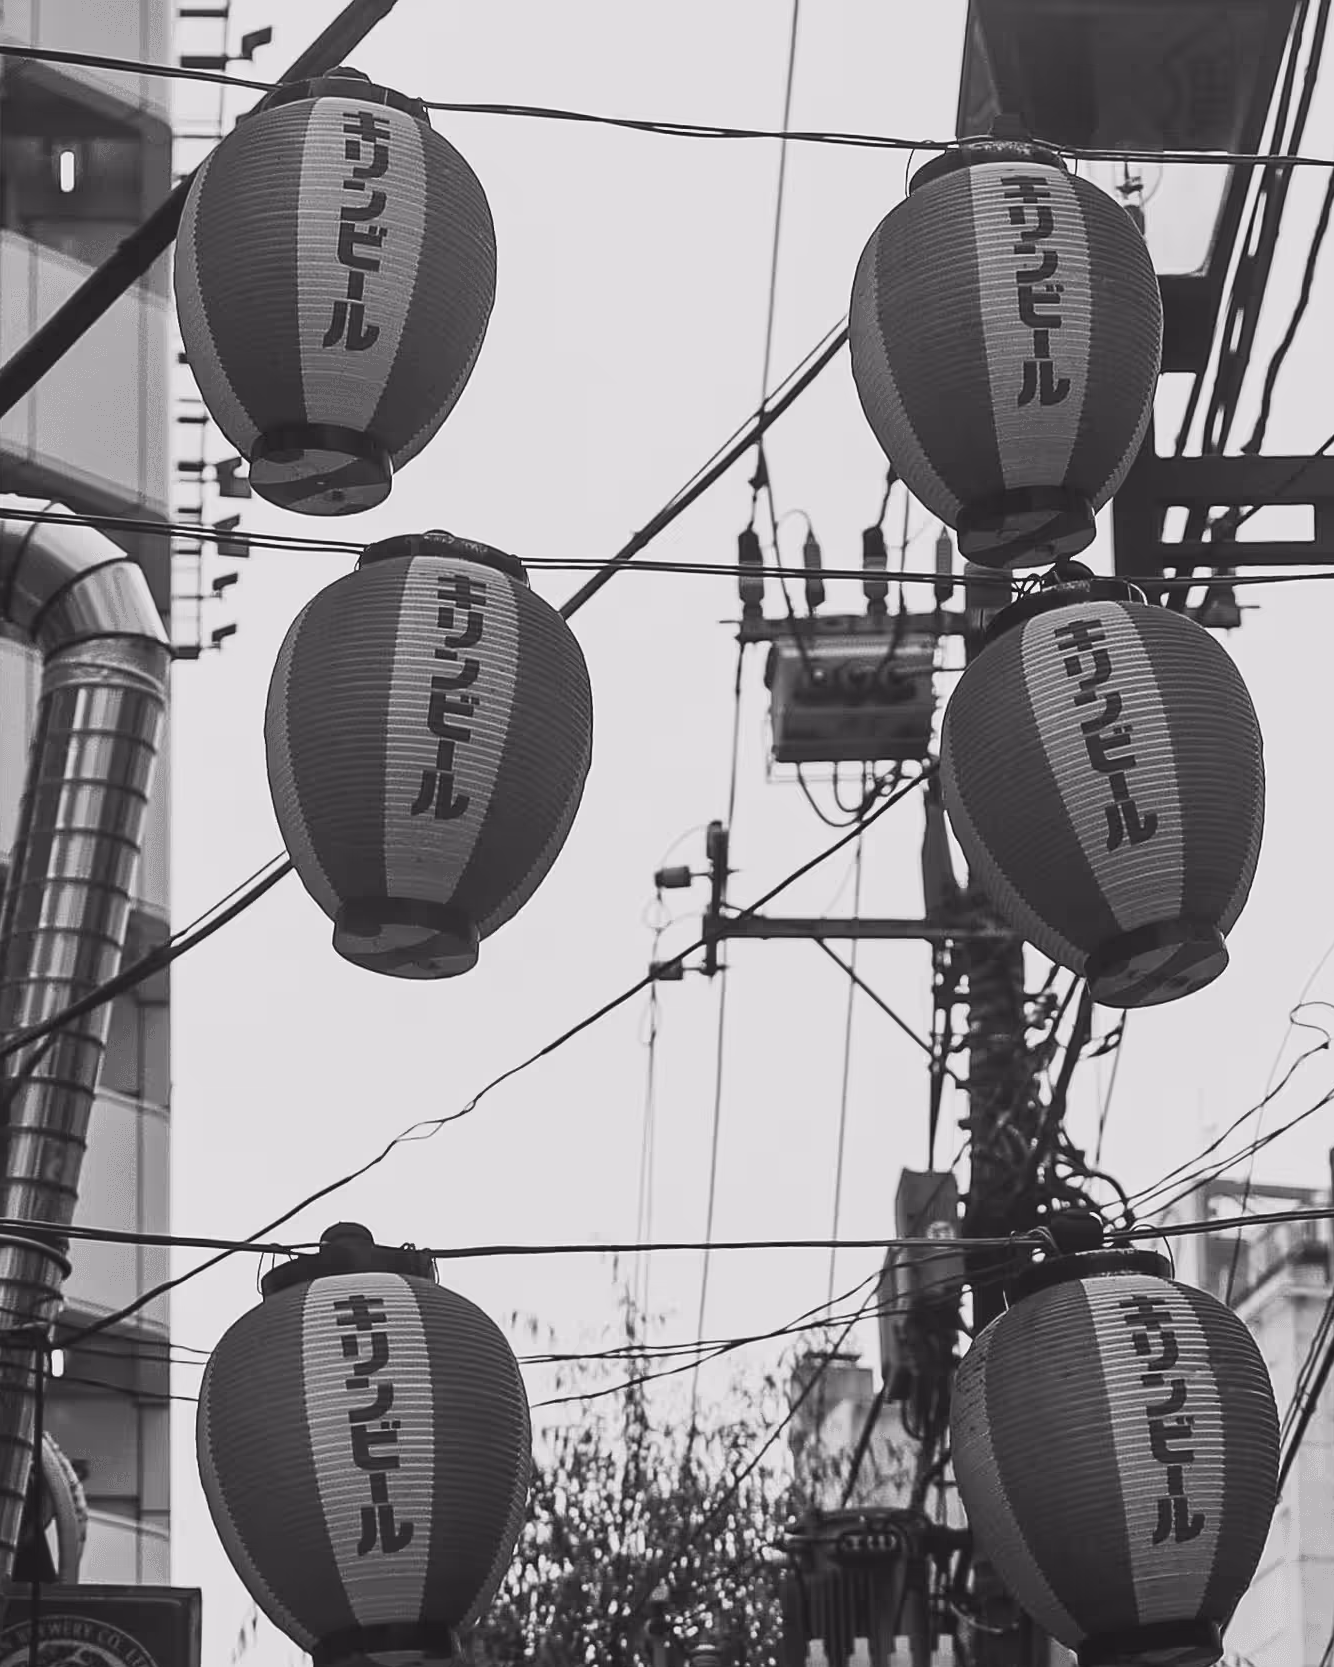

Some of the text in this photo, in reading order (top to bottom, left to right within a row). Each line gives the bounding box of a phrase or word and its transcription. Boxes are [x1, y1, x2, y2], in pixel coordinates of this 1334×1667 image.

[323, 111, 391, 352] キリンビール
[1001, 175, 1071, 407] キリンビール
[411, 574, 487, 820] キリンビール
[1054, 619, 1159, 851] キリンビール
[334, 1295, 414, 1556] キリンビール
[1118, 1293, 1205, 1545] キリンビール
